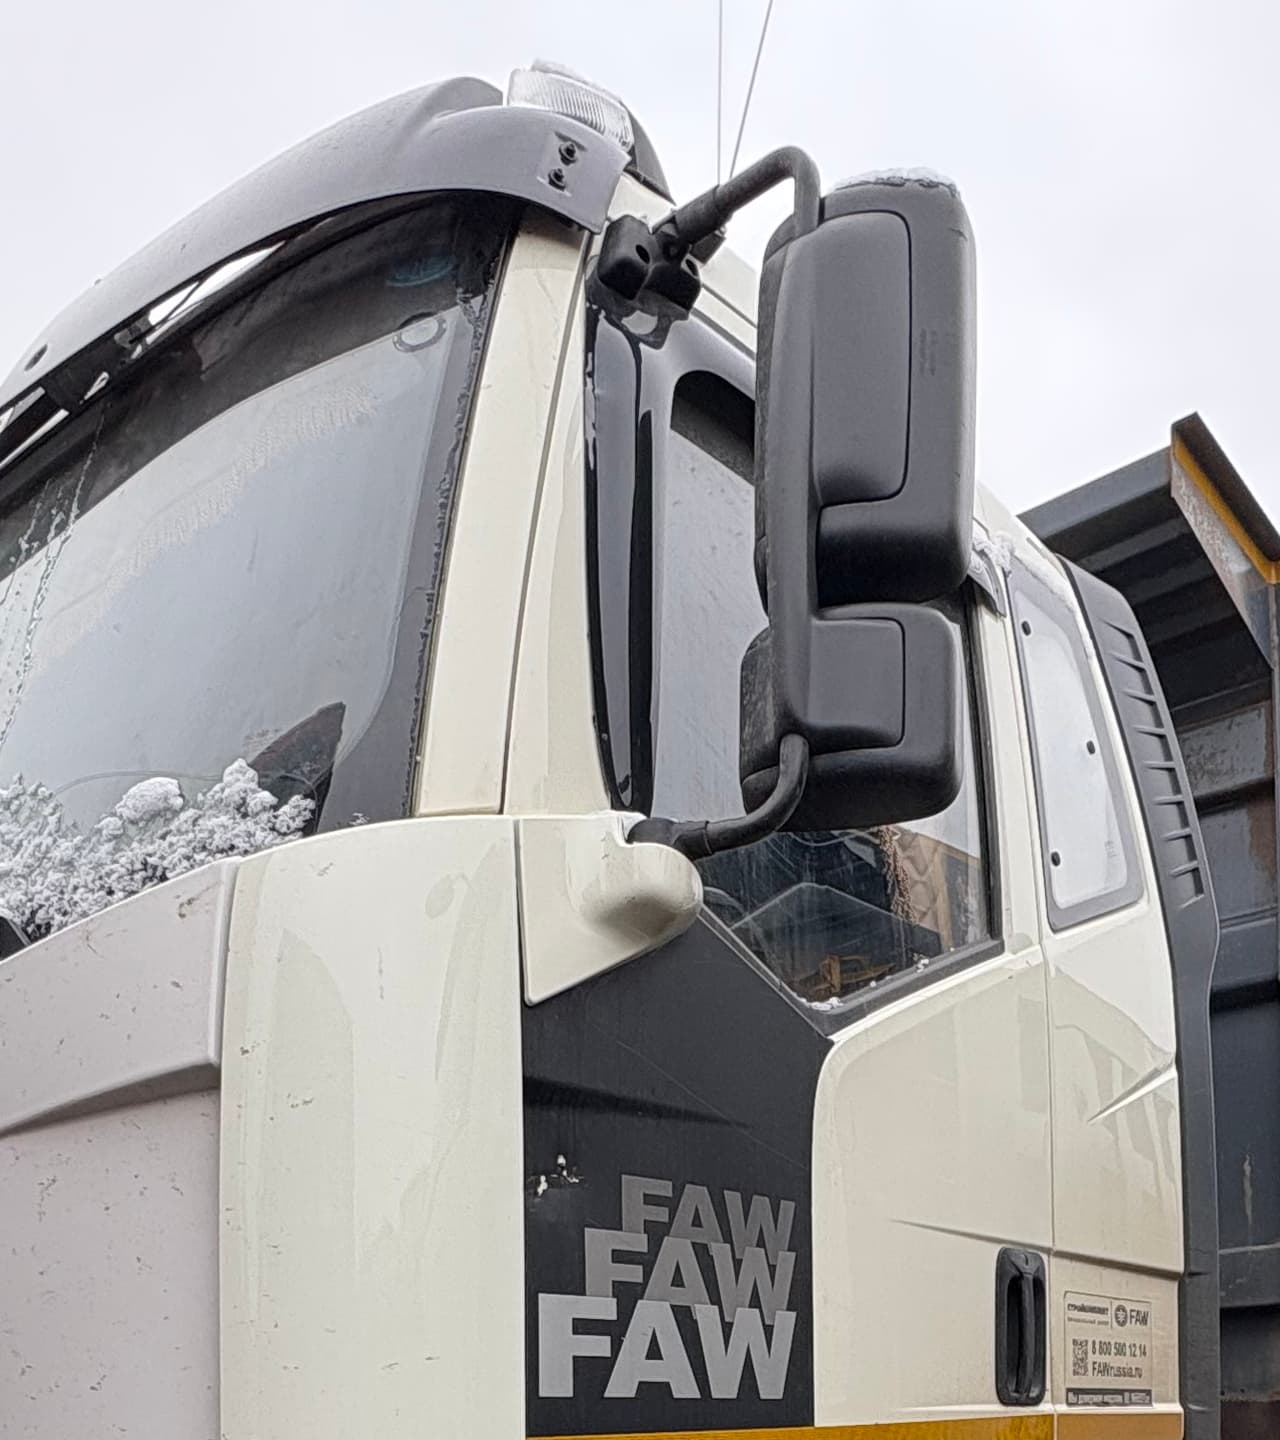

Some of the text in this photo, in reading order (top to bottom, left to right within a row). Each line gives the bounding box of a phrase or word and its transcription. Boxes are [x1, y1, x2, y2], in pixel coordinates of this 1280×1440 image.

[621, 1173, 796, 1264] FAW
[584, 1227, 797, 1325] FAW
[1129, 1308, 1150, 1326] FAW
[537, 1292, 798, 1400] FAW
